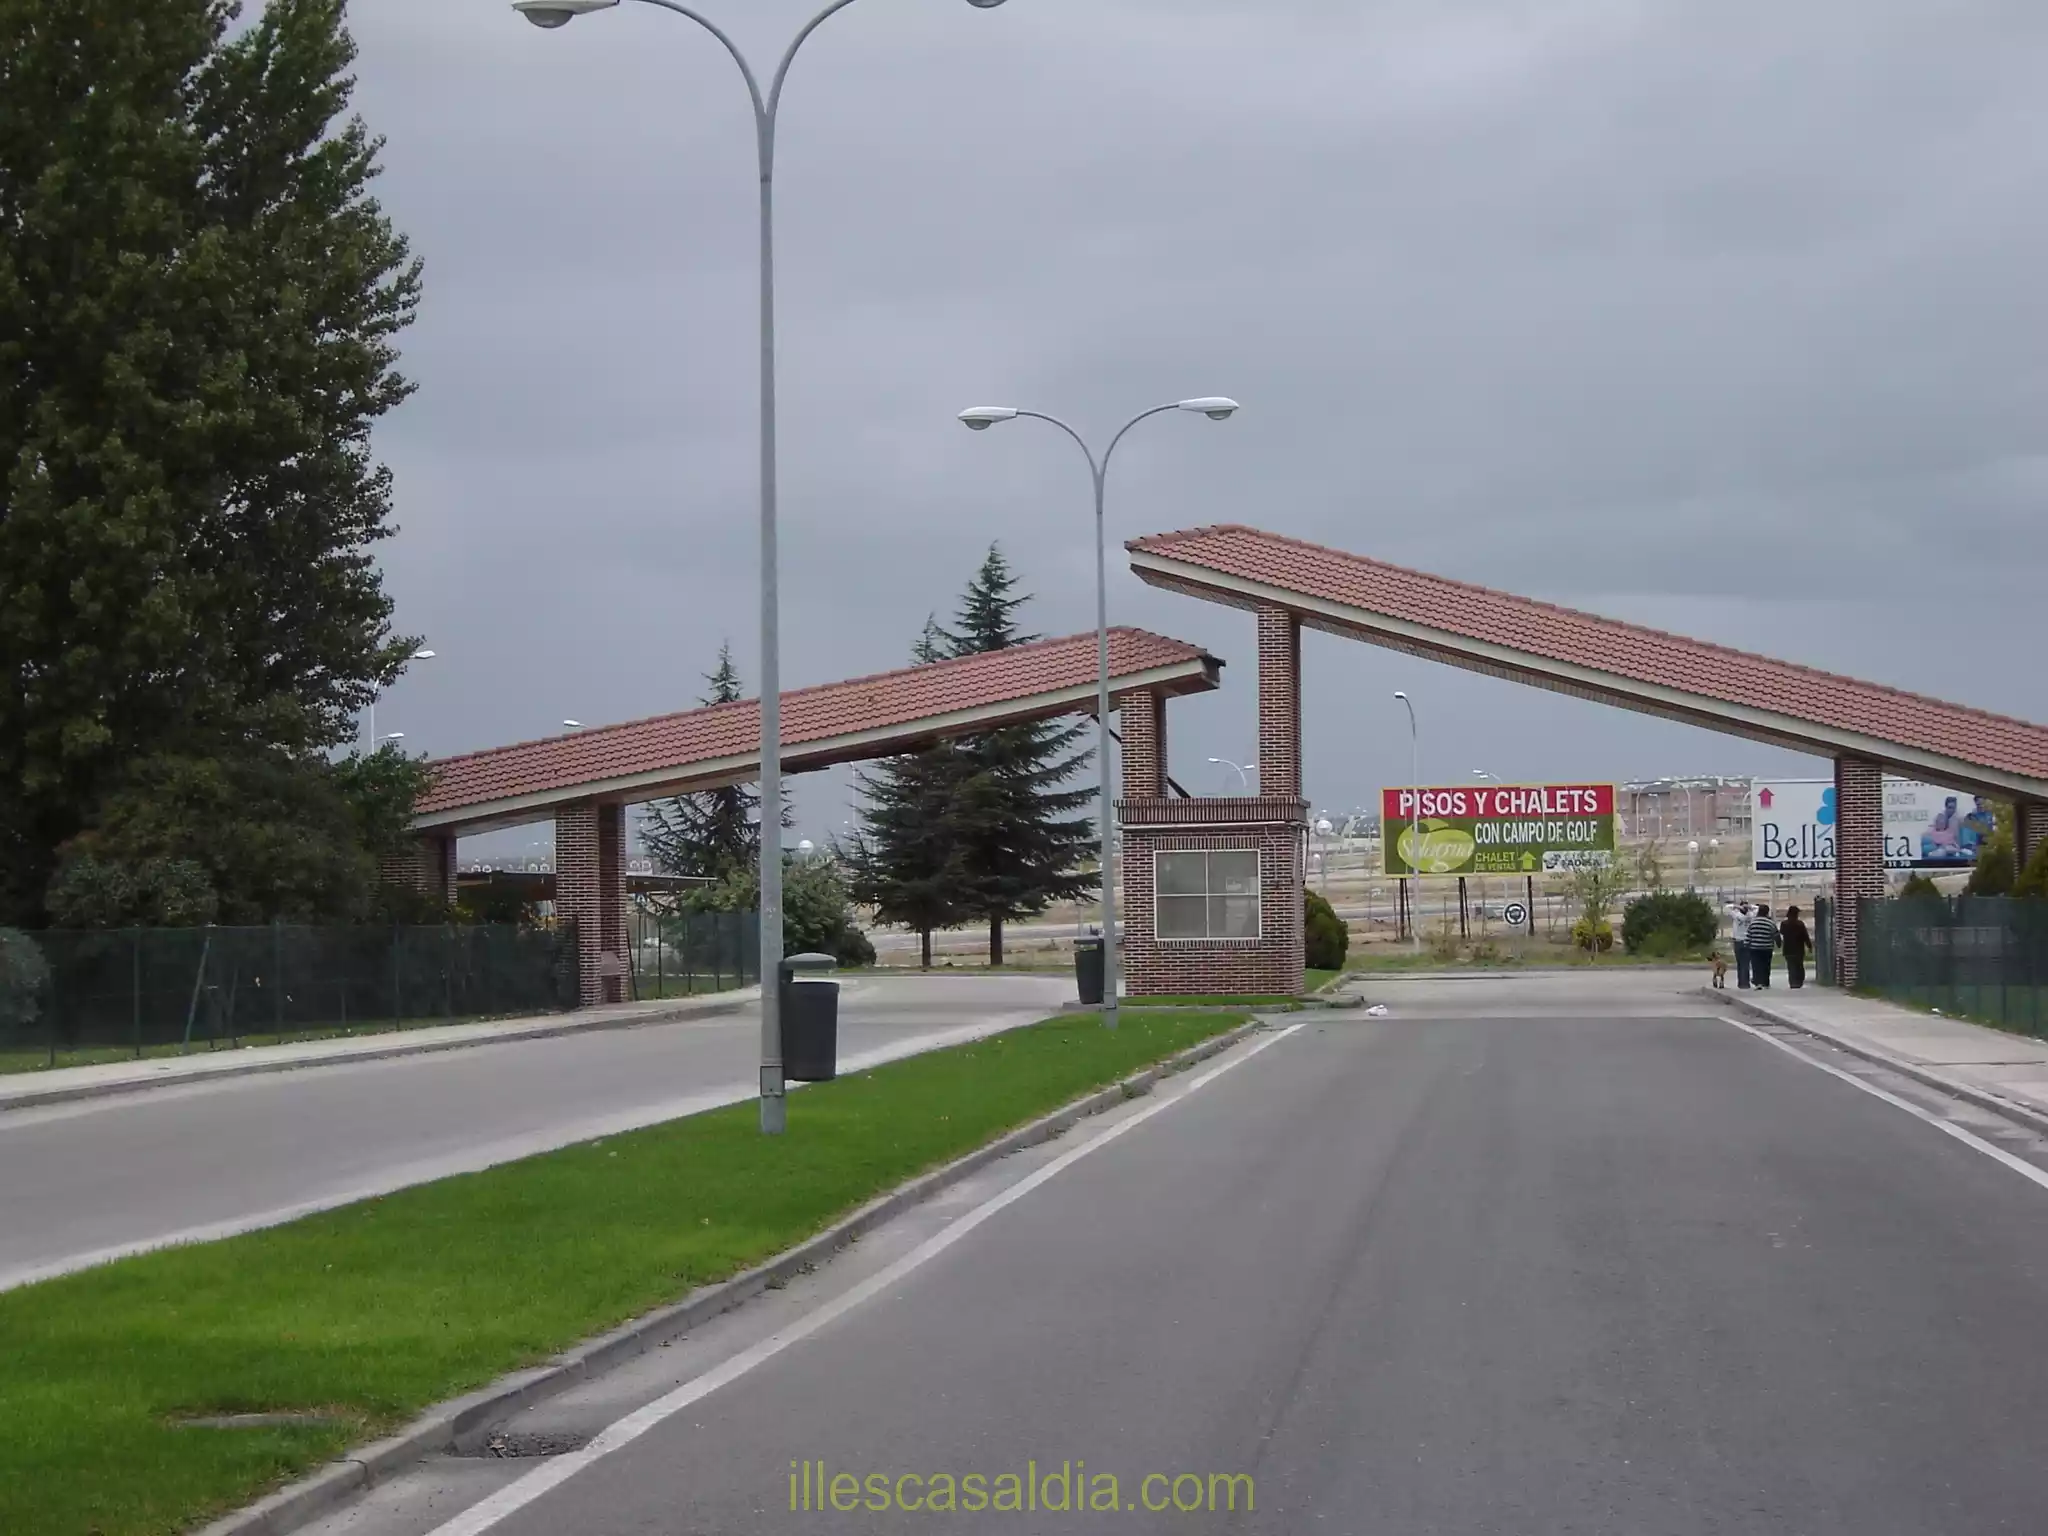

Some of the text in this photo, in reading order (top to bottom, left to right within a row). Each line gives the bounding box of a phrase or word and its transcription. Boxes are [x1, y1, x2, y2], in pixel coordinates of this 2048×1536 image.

[1399, 789, 1598, 816] PISOS Y CHALETS
[1475, 820, 1598, 844] CON CAMPO DE GOLF
[1475, 851, 1515, 863] CHALET
